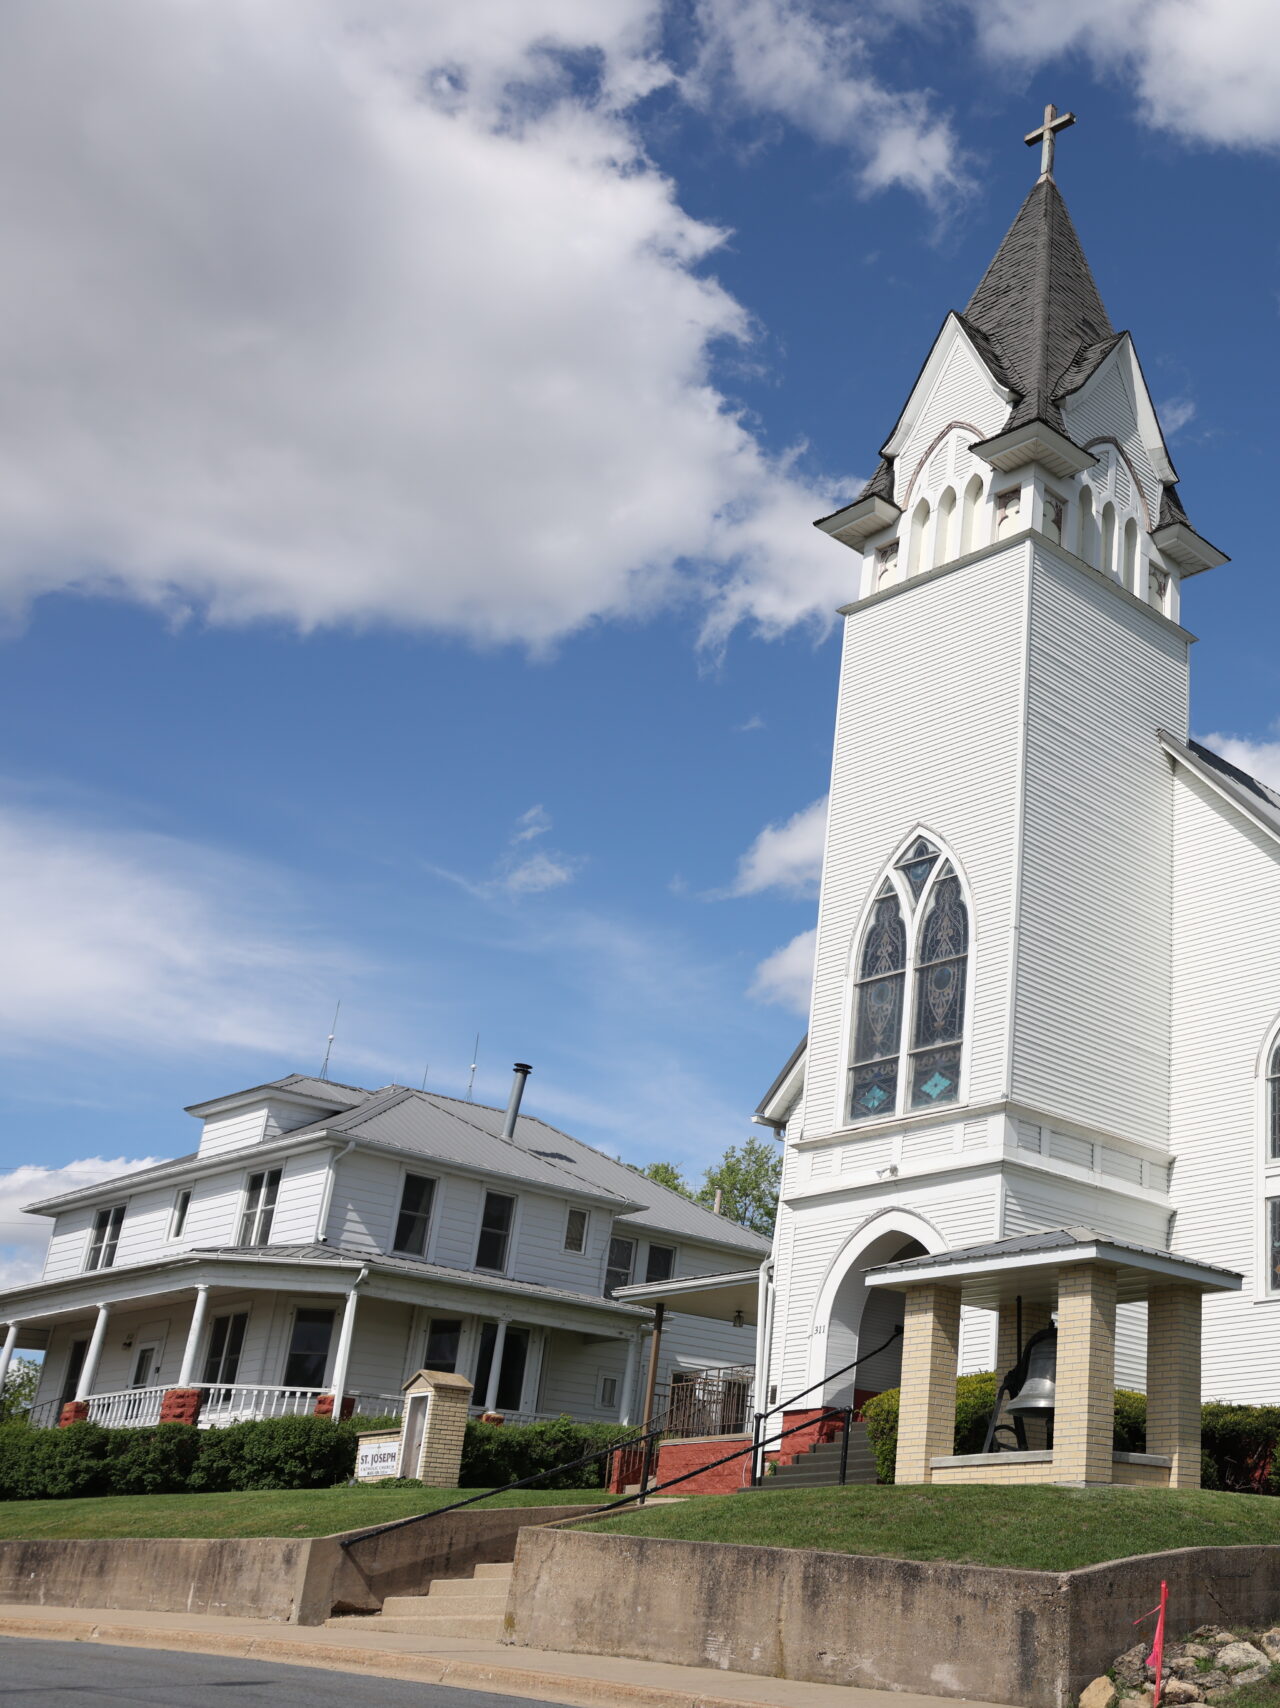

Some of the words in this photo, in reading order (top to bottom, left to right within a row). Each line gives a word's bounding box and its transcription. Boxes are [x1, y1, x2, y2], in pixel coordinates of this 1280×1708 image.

[814, 1325, 825, 1334] 311
[361, 1455, 369, 1464] ST.
[371, 1453, 396, 1466] JOSEPH
